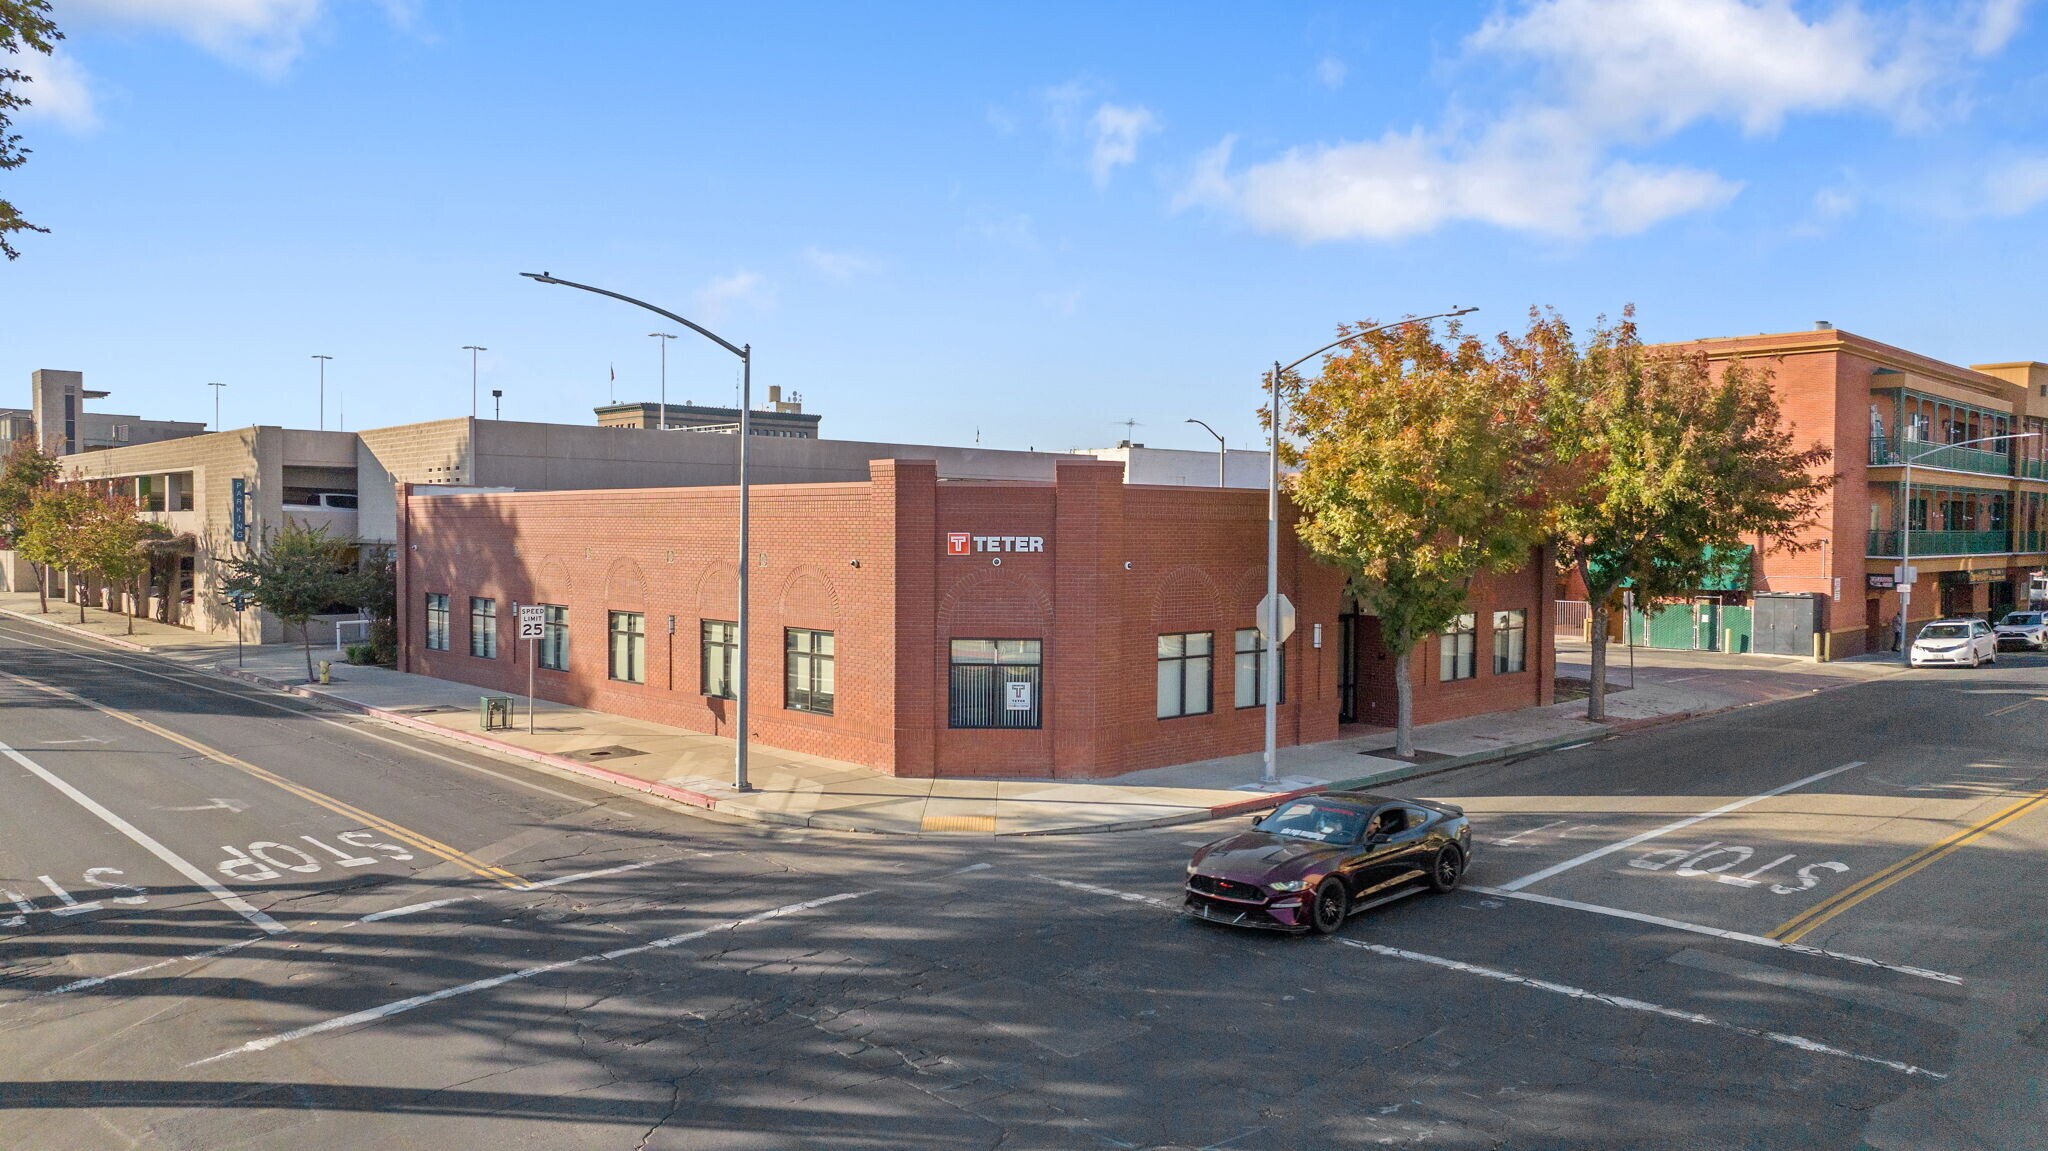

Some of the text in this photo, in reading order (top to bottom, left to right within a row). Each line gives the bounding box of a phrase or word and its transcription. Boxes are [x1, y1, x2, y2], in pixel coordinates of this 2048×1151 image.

[950, 536, 1044, 552] T TETER
[523, 624, 542, 635] 25
[1012, 685, 1025, 698] T
[217, 832, 414, 881] STOP
[1628, 841, 1850, 894] STOP
[0, 867, 148, 927] ST
